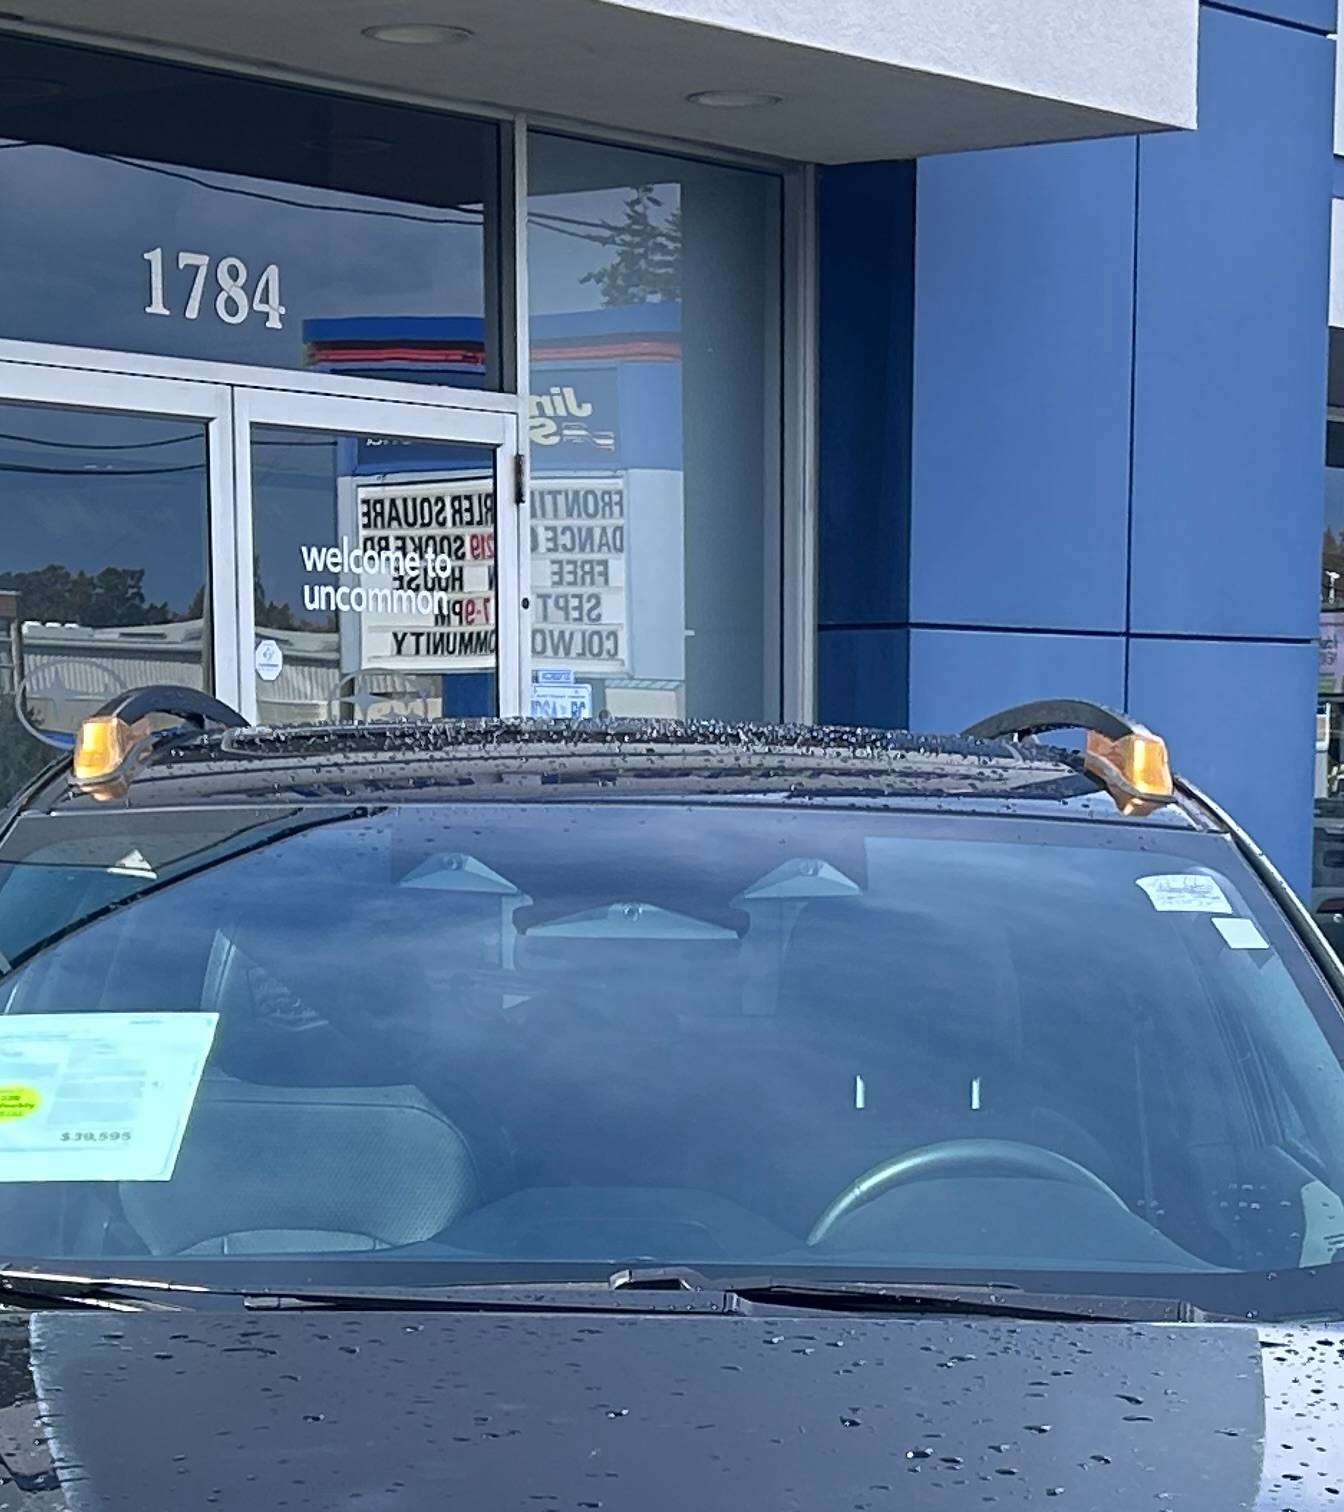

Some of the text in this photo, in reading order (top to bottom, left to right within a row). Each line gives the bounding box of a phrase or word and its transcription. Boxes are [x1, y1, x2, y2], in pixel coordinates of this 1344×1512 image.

[142, 247, 286, 330] 1784
[301, 536, 421, 578] welcome
[425, 547, 452, 579] to
[303, 583, 449, 615] uncommon
